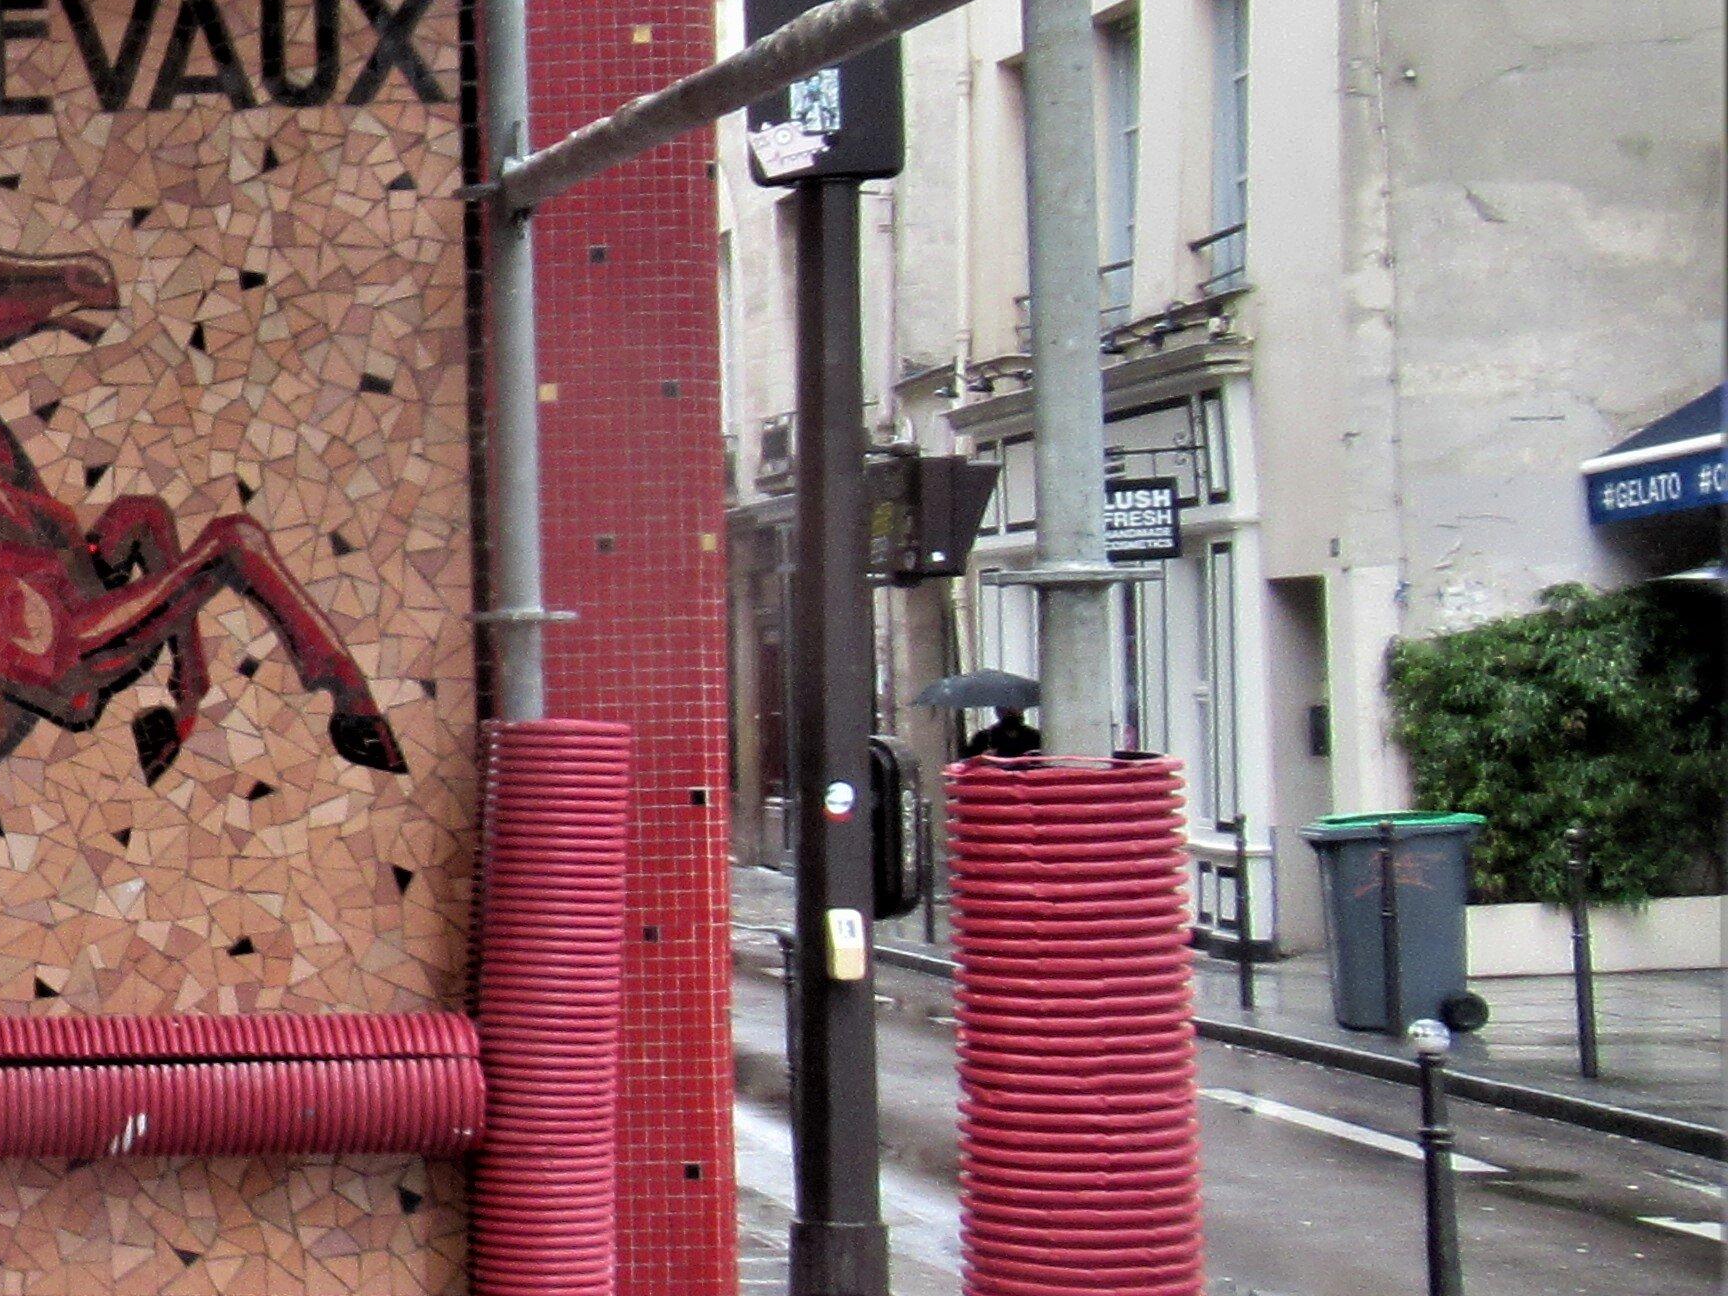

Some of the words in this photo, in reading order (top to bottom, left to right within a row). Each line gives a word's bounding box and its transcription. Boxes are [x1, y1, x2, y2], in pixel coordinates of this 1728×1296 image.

[1104, 489, 1172, 510] LUSH
[1602, 471, 1681, 511] #GELATO
[1103, 510, 1172, 528] FRESH
